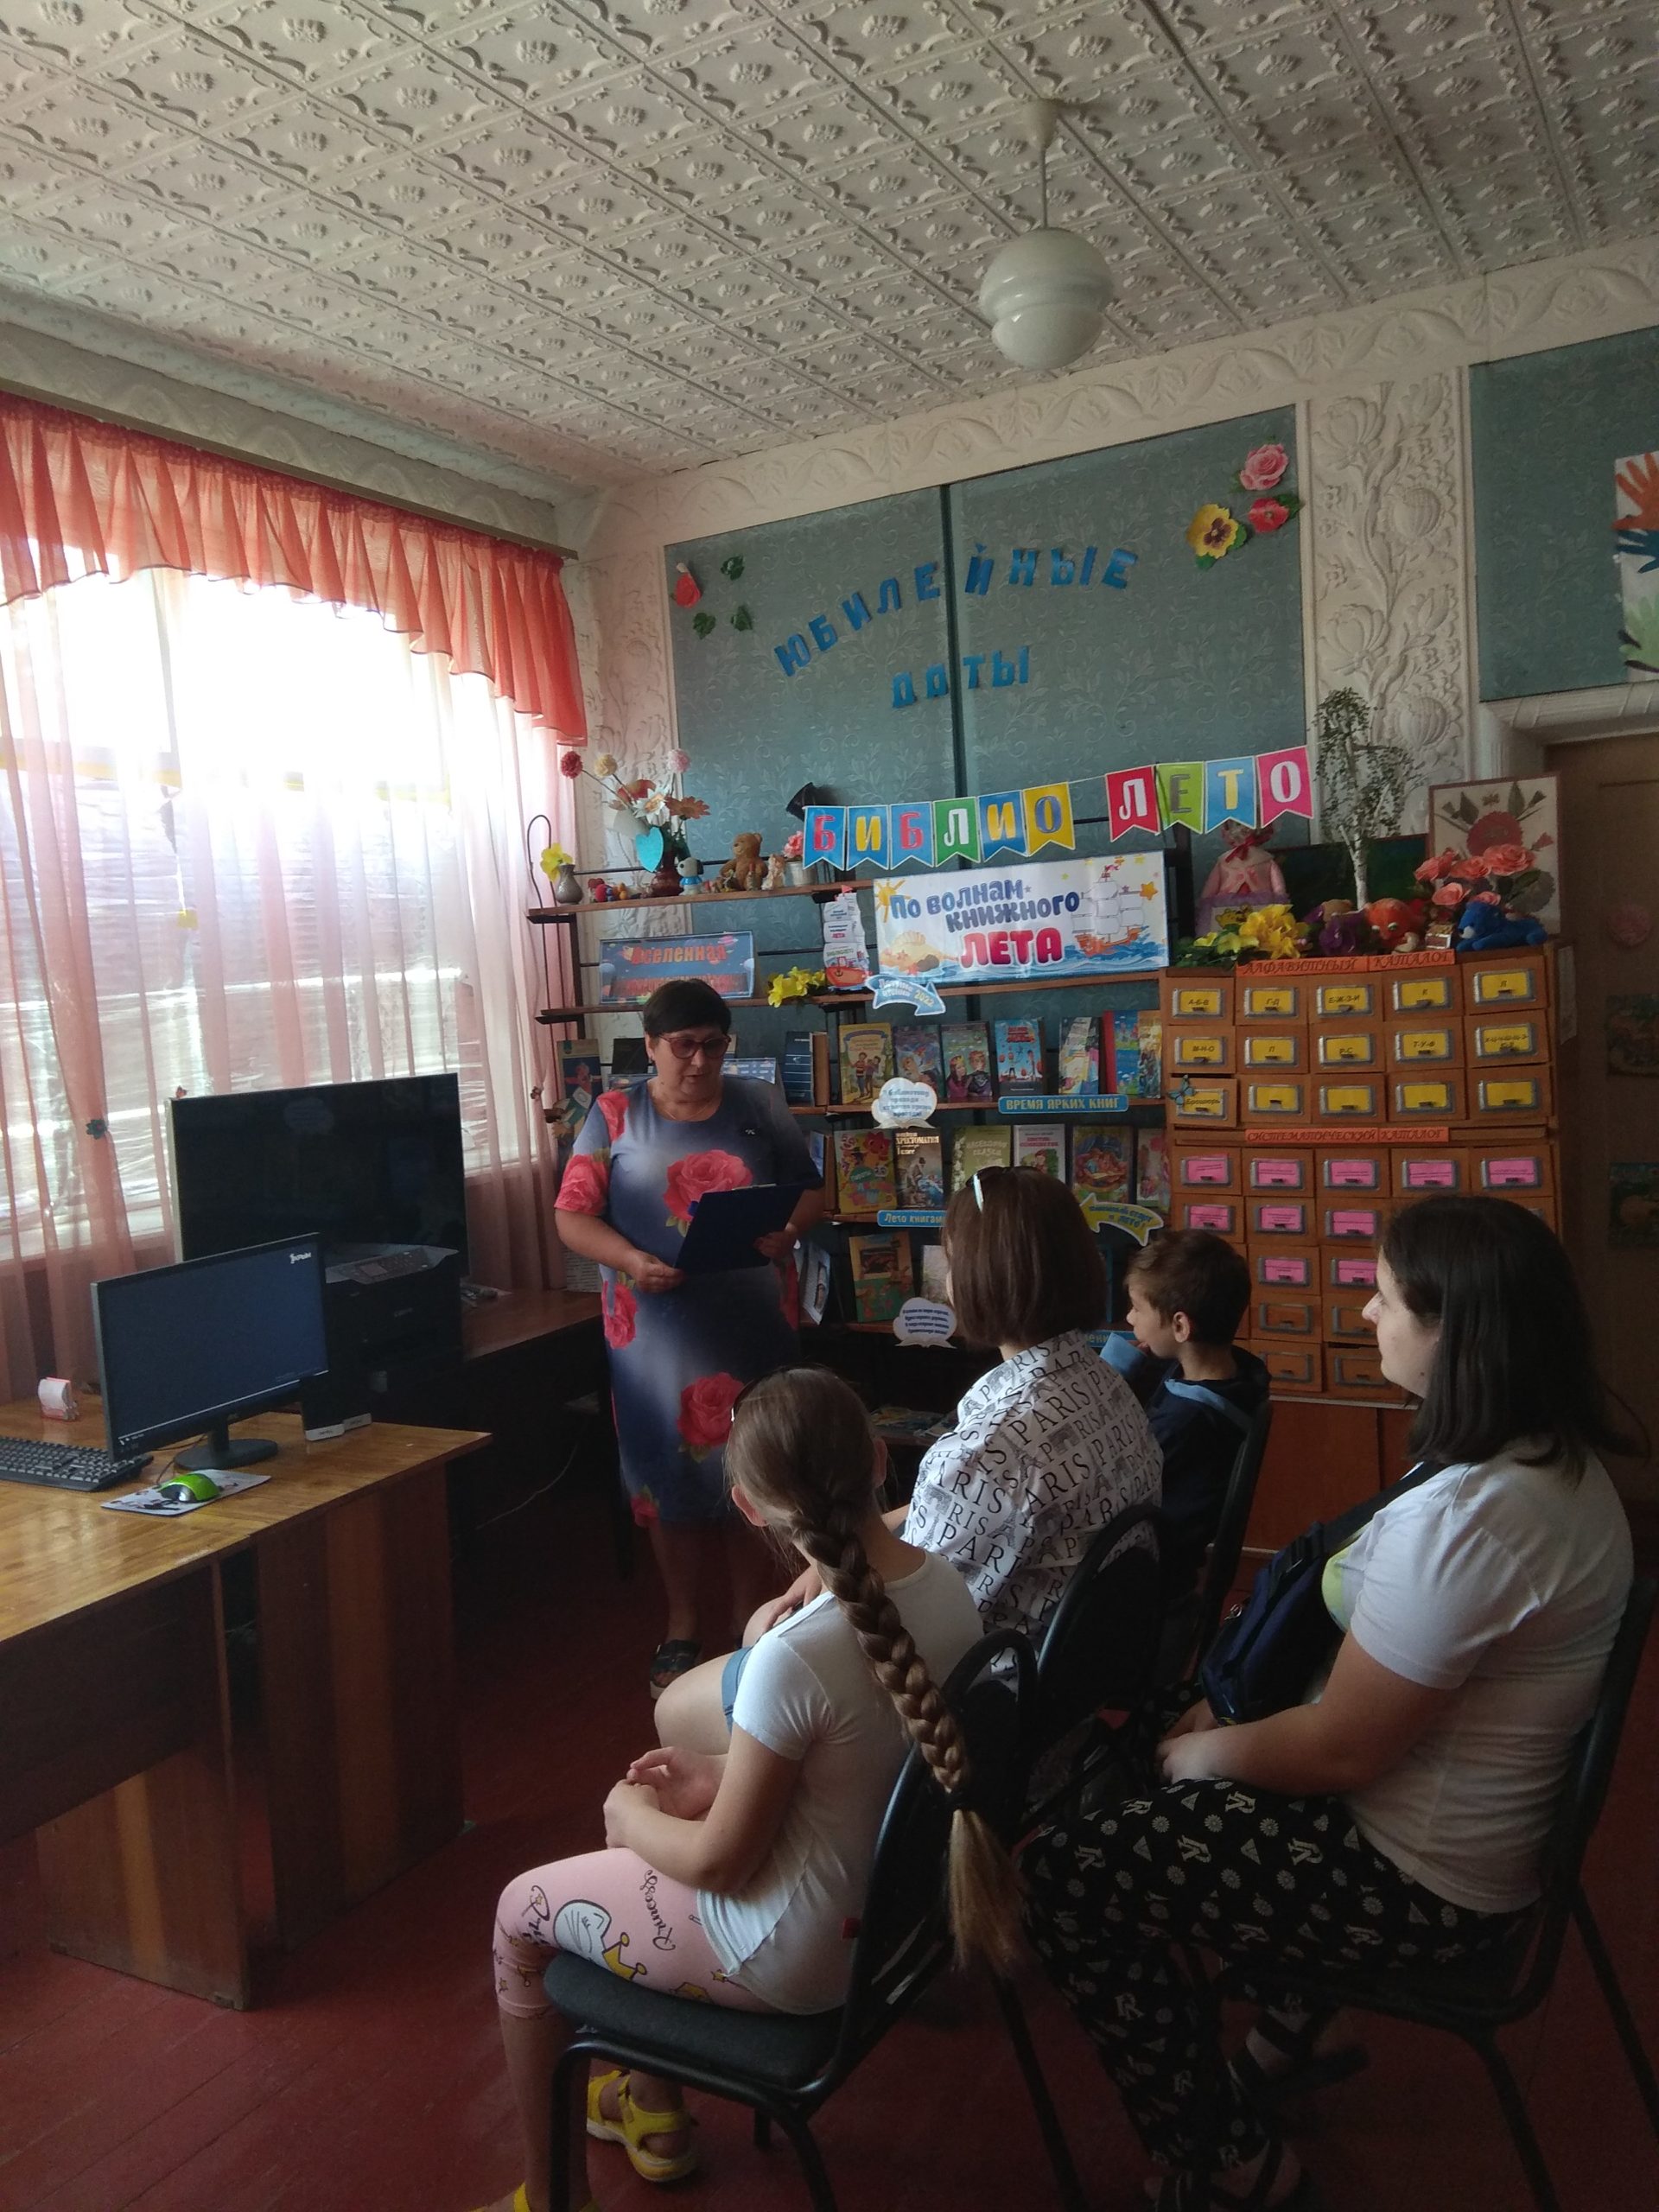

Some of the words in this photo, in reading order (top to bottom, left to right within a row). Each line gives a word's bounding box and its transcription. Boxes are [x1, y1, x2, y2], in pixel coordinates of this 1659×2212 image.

[774, 543, 1138, 677] ЮБИЛЕЙНЫЕ
[892, 645, 1029, 708] ДАТЫ
[813, 795, 1062, 851] БИБЛИО
[1118, 760, 1301, 820] ЛЕТО
[890, 894, 921, 918] По
[927, 879, 1024, 915] волнам
[945, 892, 1080, 933] книжного
[960, 928, 1063, 969] ЛЕТА
[1375, 951, 1451, 968] КАТАЛОГ
[1006, 1099, 1043, 1110] ВРЕМЯ
[1047, 1098, 1085, 1110] ЯРКИХ
[1089, 1097, 1120, 1109] КНИГ
[884, 1213, 906, 1223] Лето
[909, 1215, 946, 1224] книгам
[1008, 1382, 1090, 1446] PARIS
[1091, 1414, 1135, 1466] PARIS
